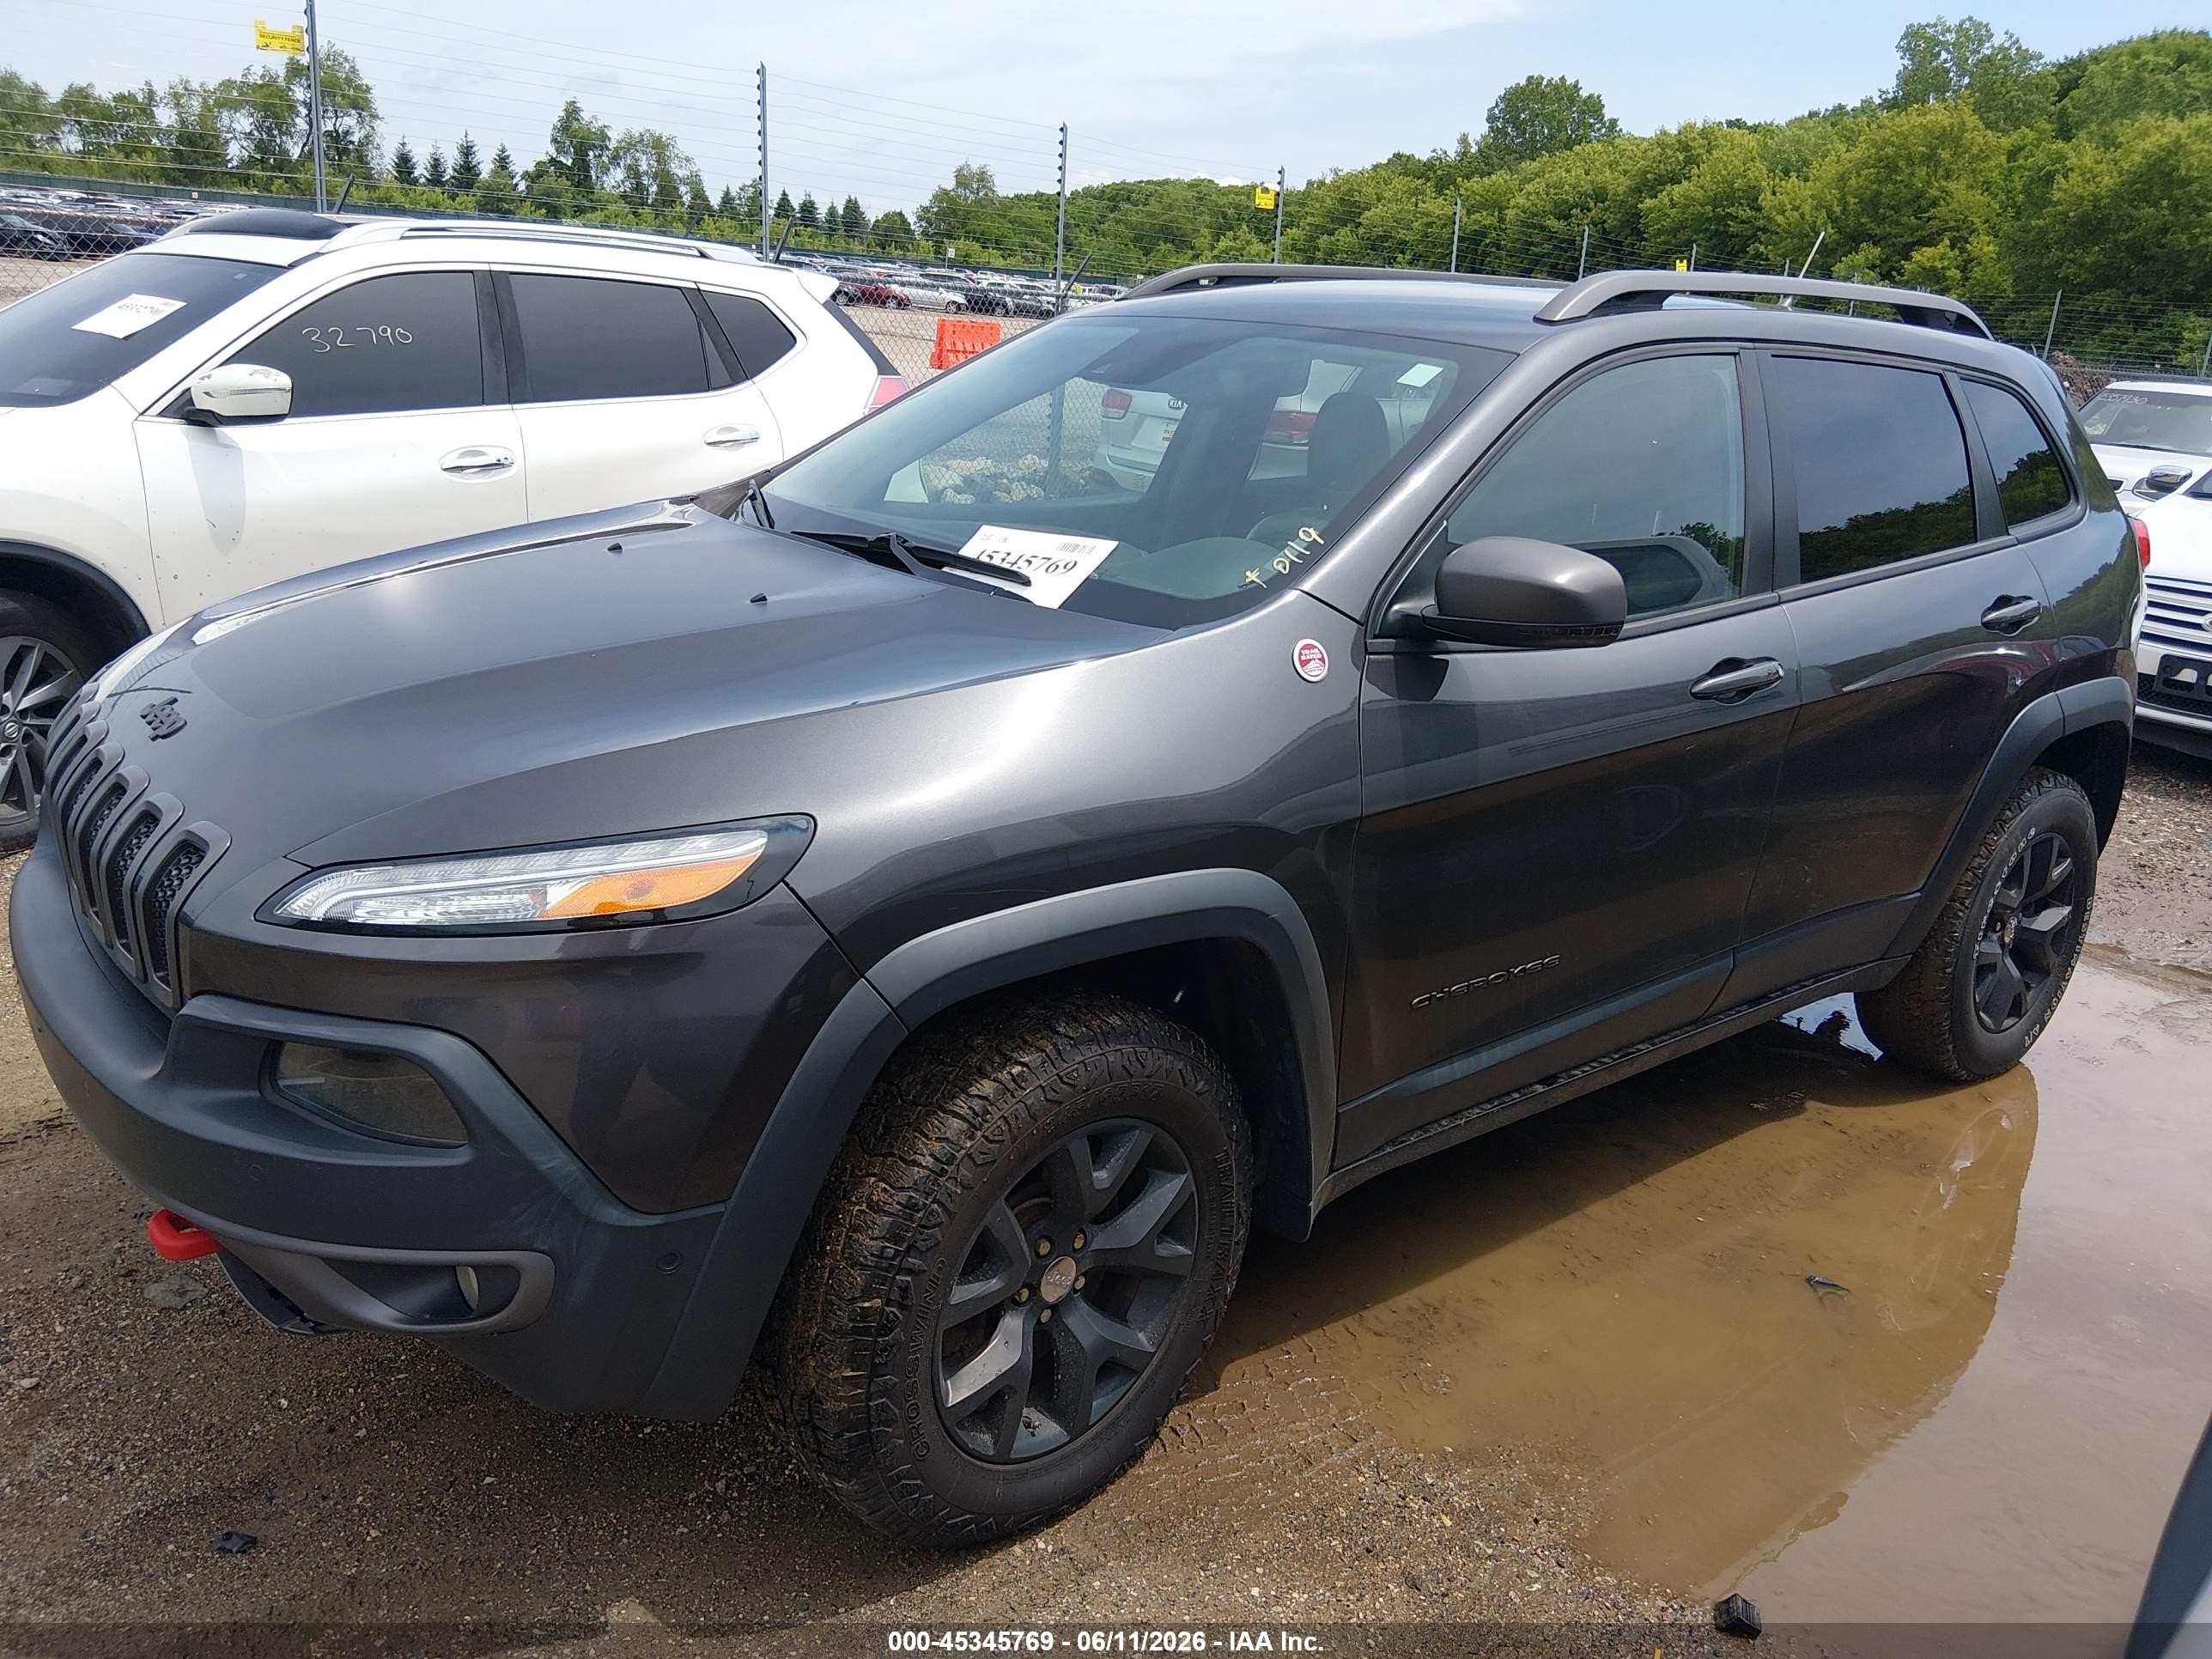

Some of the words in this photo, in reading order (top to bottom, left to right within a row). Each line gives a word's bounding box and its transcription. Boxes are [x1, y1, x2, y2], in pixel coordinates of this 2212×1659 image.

[301, 325, 413, 353] 32790
[1169, 399, 1182, 409] KIA
[1410, 953, 1560, 1009] CHEROKEE
[905, 1256, 946, 1460] CROSSWIND
